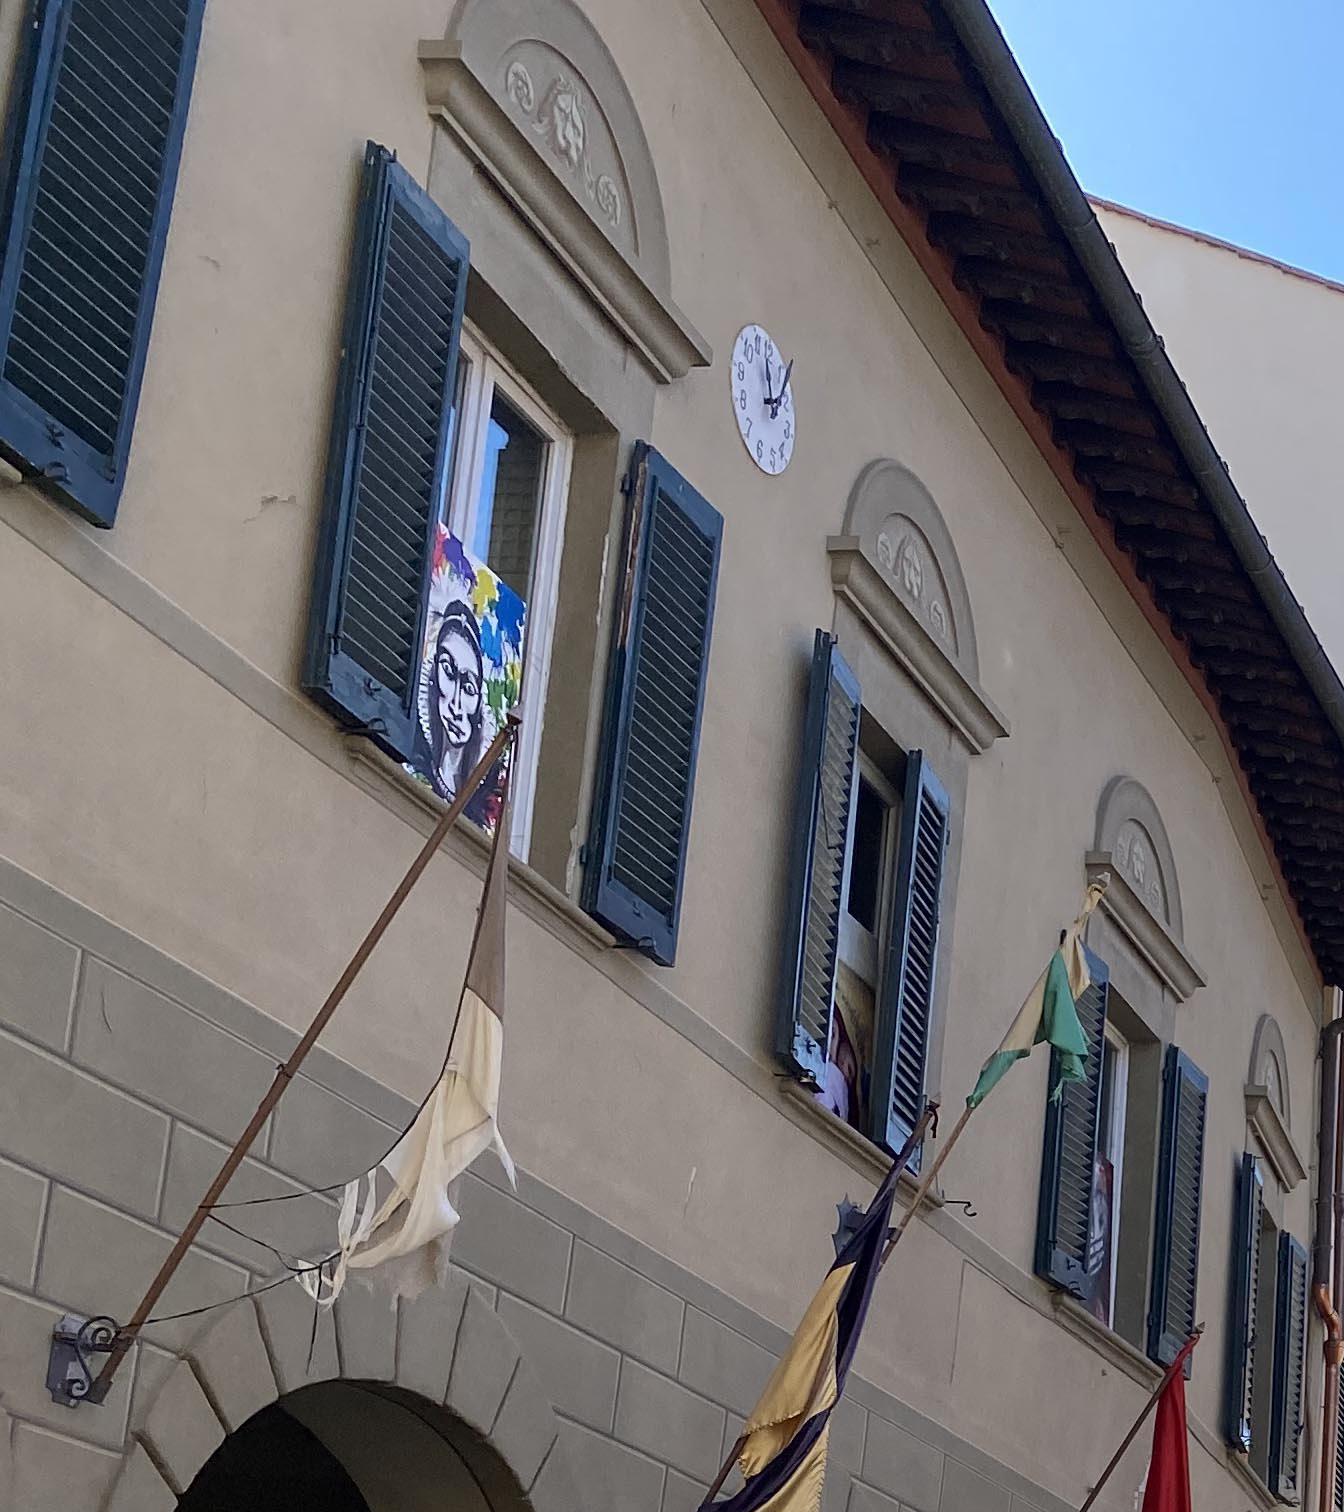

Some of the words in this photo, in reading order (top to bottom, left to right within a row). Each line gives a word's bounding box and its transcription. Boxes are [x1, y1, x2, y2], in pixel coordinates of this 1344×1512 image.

[743, 337, 754, 364] 10
[764, 339, 773, 365] 12
[737, 361, 745, 381] 9
[740, 389, 747, 411] 8
[745, 417, 753, 440] 7
[783, 420, 791, 440] 3
[756, 439, 764, 459] 6
[769, 447, 777, 473] 5
